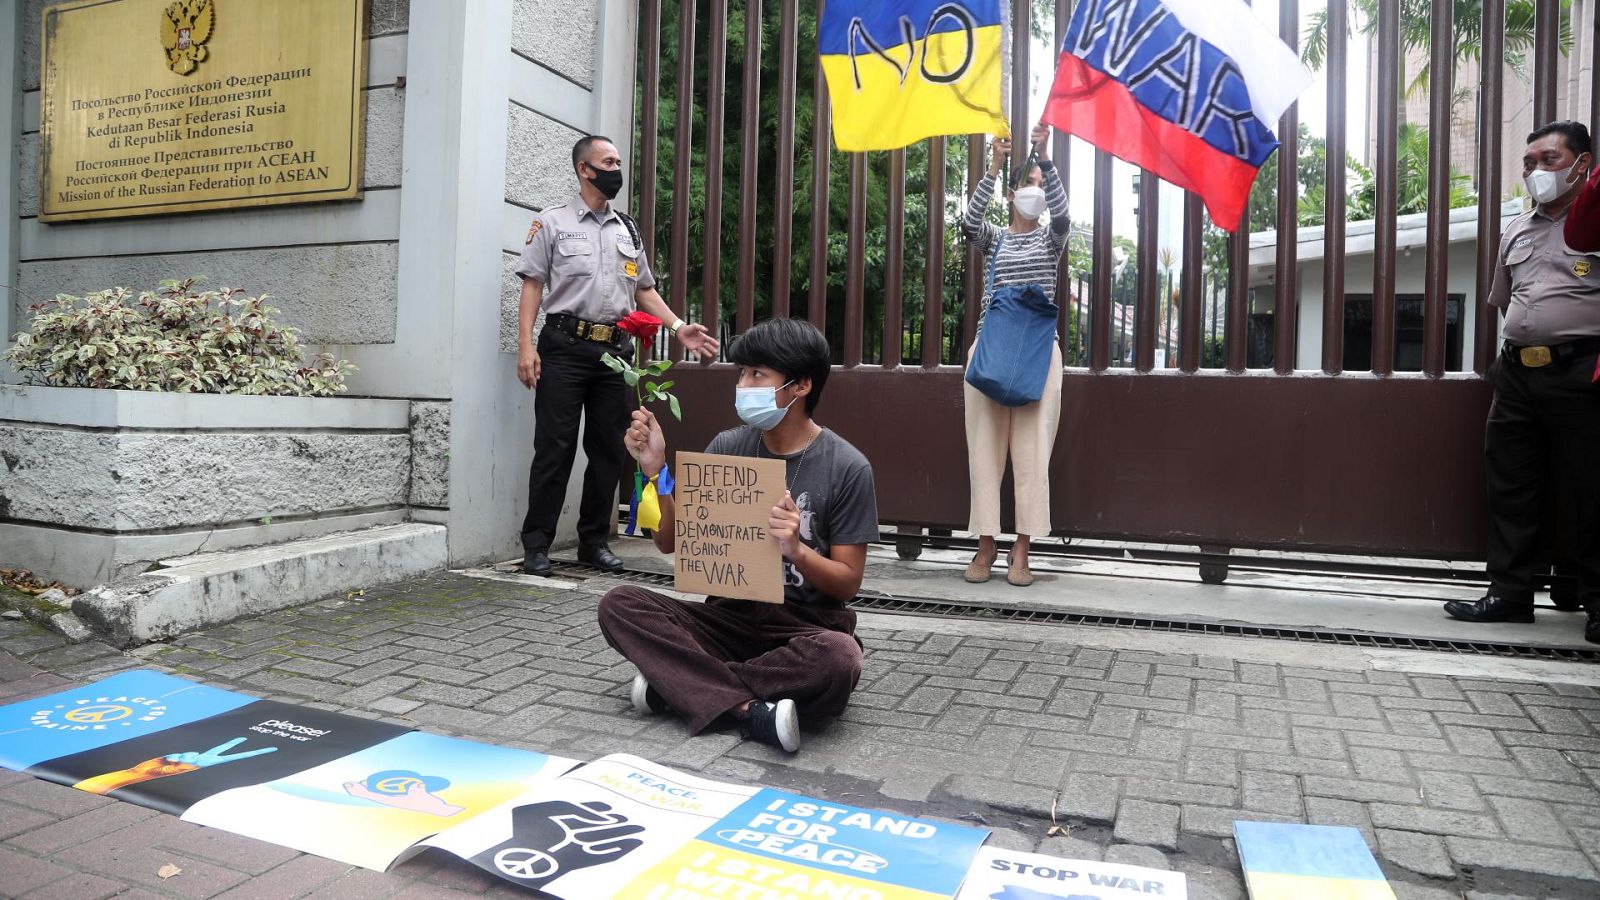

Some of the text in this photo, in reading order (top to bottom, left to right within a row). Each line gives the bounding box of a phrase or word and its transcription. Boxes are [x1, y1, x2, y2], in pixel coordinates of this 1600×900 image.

[847, 2, 977, 93] NO
[72, 68, 311, 110] Посольство Российской Федерации
[1073, 0, 1254, 160] WAR
[87, 102, 286, 138] Kedutaan Besar Federasi Rusia
[97, 88, 272, 120] в Республике Индонезии
[108, 121, 254, 149] di Republik Indonesia
[66, 151, 316, 187] Российской Федерации при АСЕАН
[75, 140, 294, 172] Постоянное Представительство
[58, 166, 329, 203] Mission of the Russian Federation to ASEAN
[682, 463, 758, 491] DEFEND
[676, 519, 766, 541] DEMONSTRATE
[680, 540, 731, 557] AGAINST
[680, 558, 749, 587] THE WAR
[258, 719, 332, 738] please!
[748, 813, 837, 844] FOR
[766, 799, 938, 839] I STAND
[728, 829, 881, 874] PEACE
[715, 858, 884, 900] STAND
[990, 859, 1166, 895] STOP WAR
